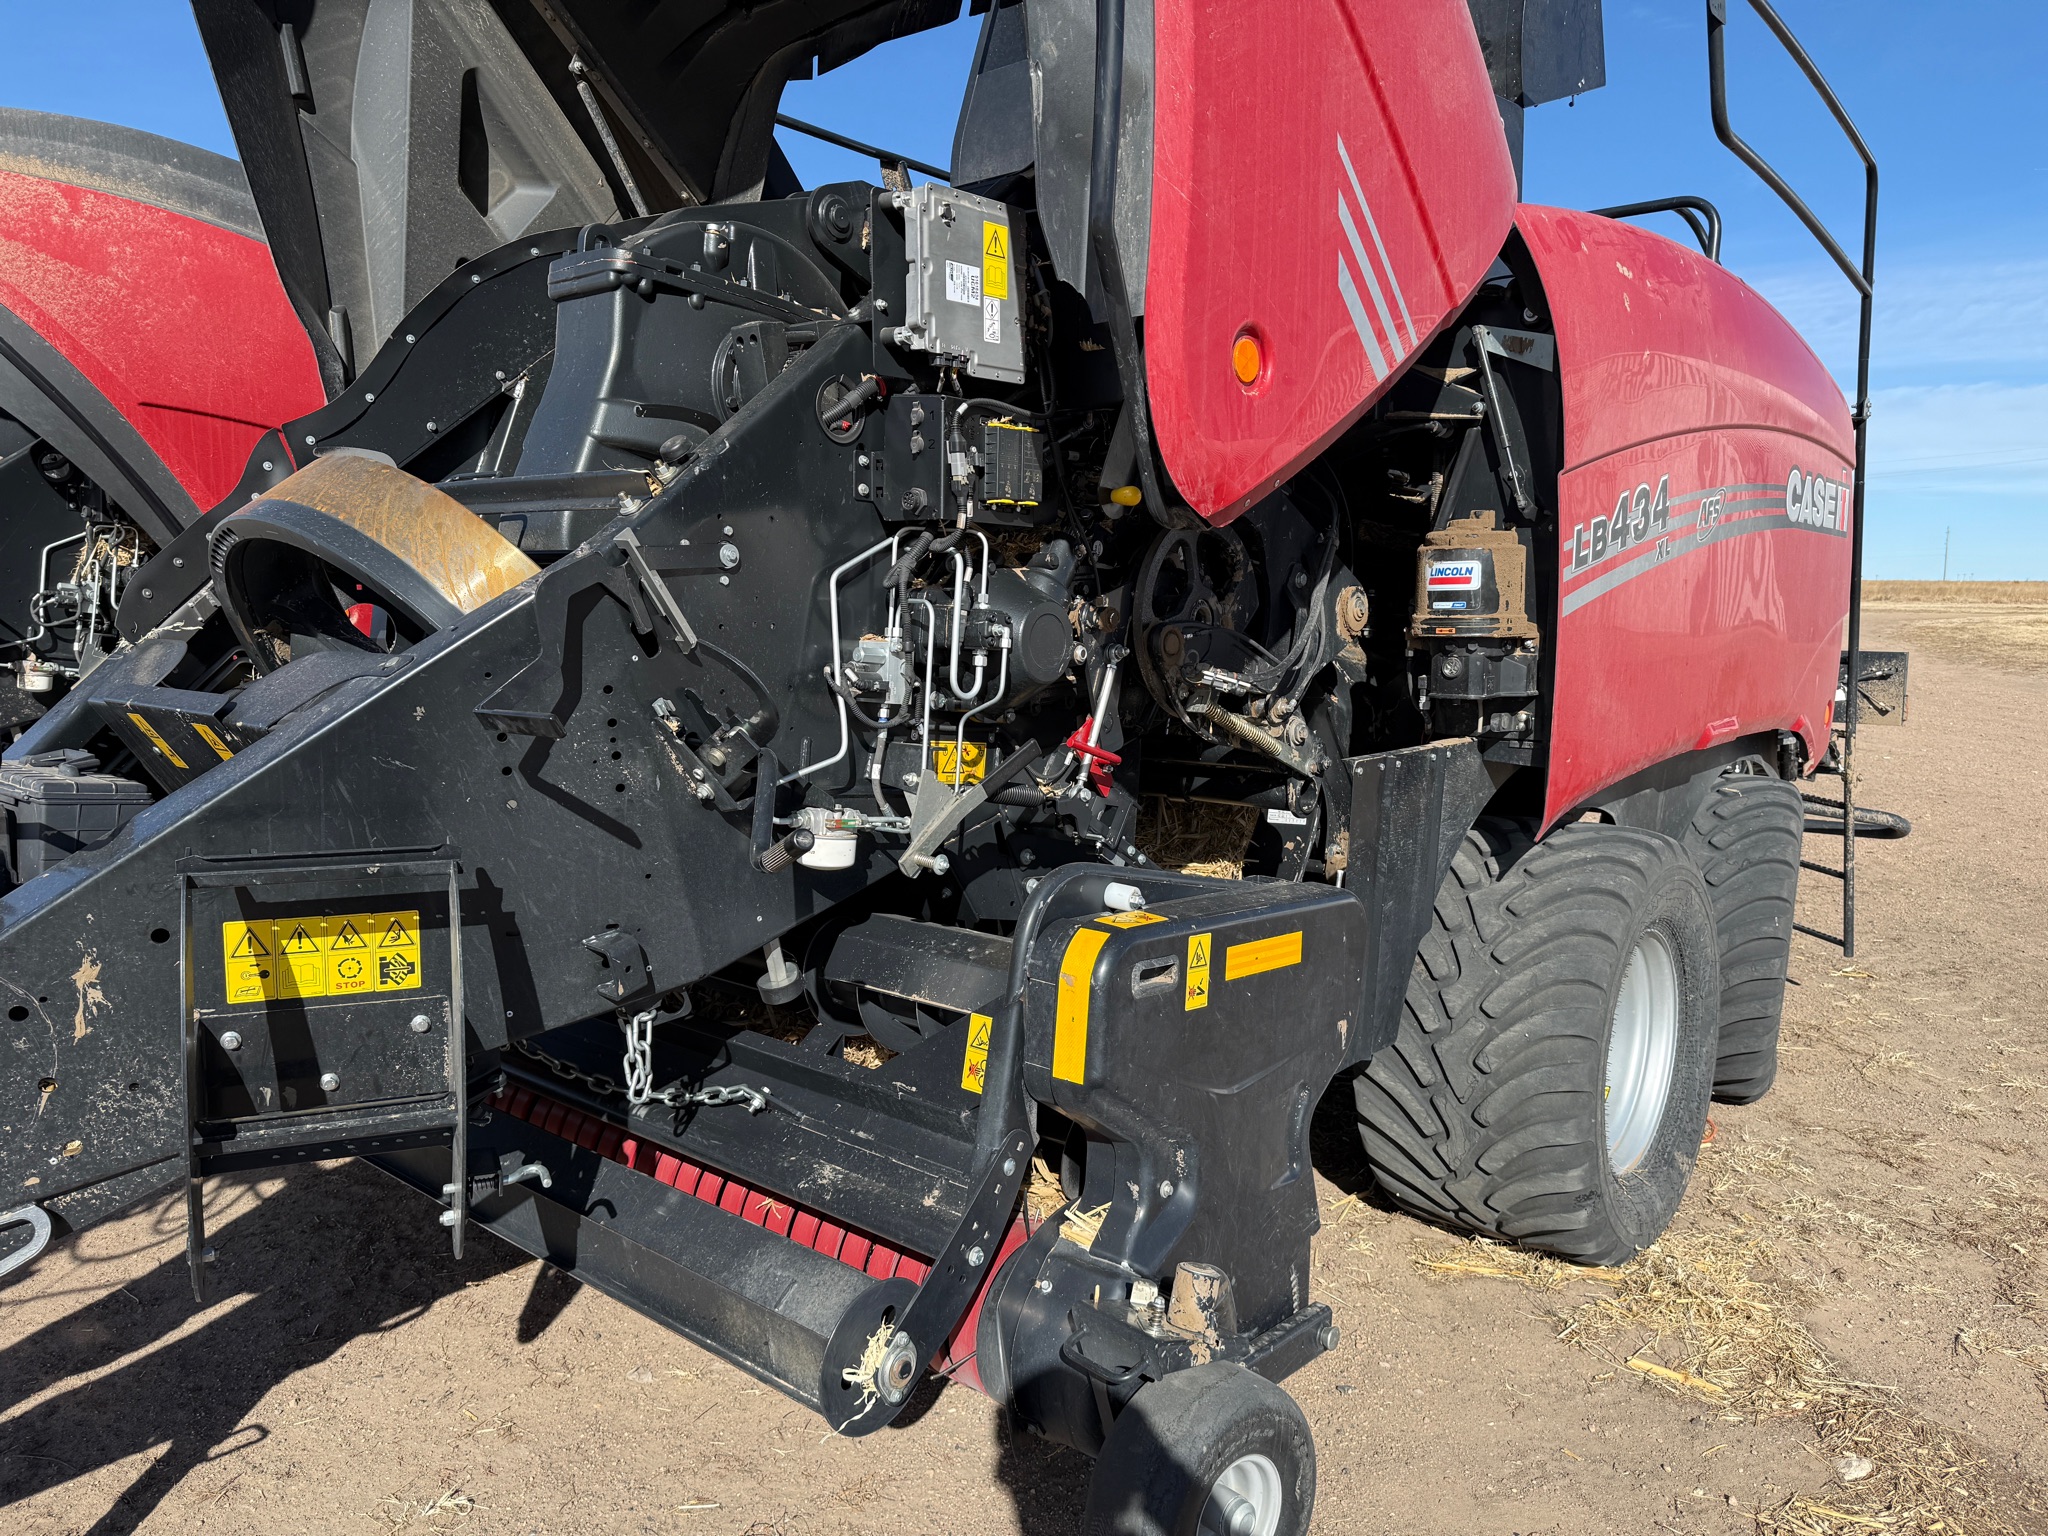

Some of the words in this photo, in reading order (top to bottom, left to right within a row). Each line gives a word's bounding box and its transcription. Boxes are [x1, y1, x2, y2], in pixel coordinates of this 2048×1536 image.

[929, 410, 935, 421] 1
[928, 438, 936, 450] 2
[1697, 495, 1722, 529] AFS
[1571, 473, 1670, 573] LB434
[1655, 536, 1671, 562] XL
[1430, 566, 1474, 576] LINCOLN
[336, 980, 365, 989] STOP
